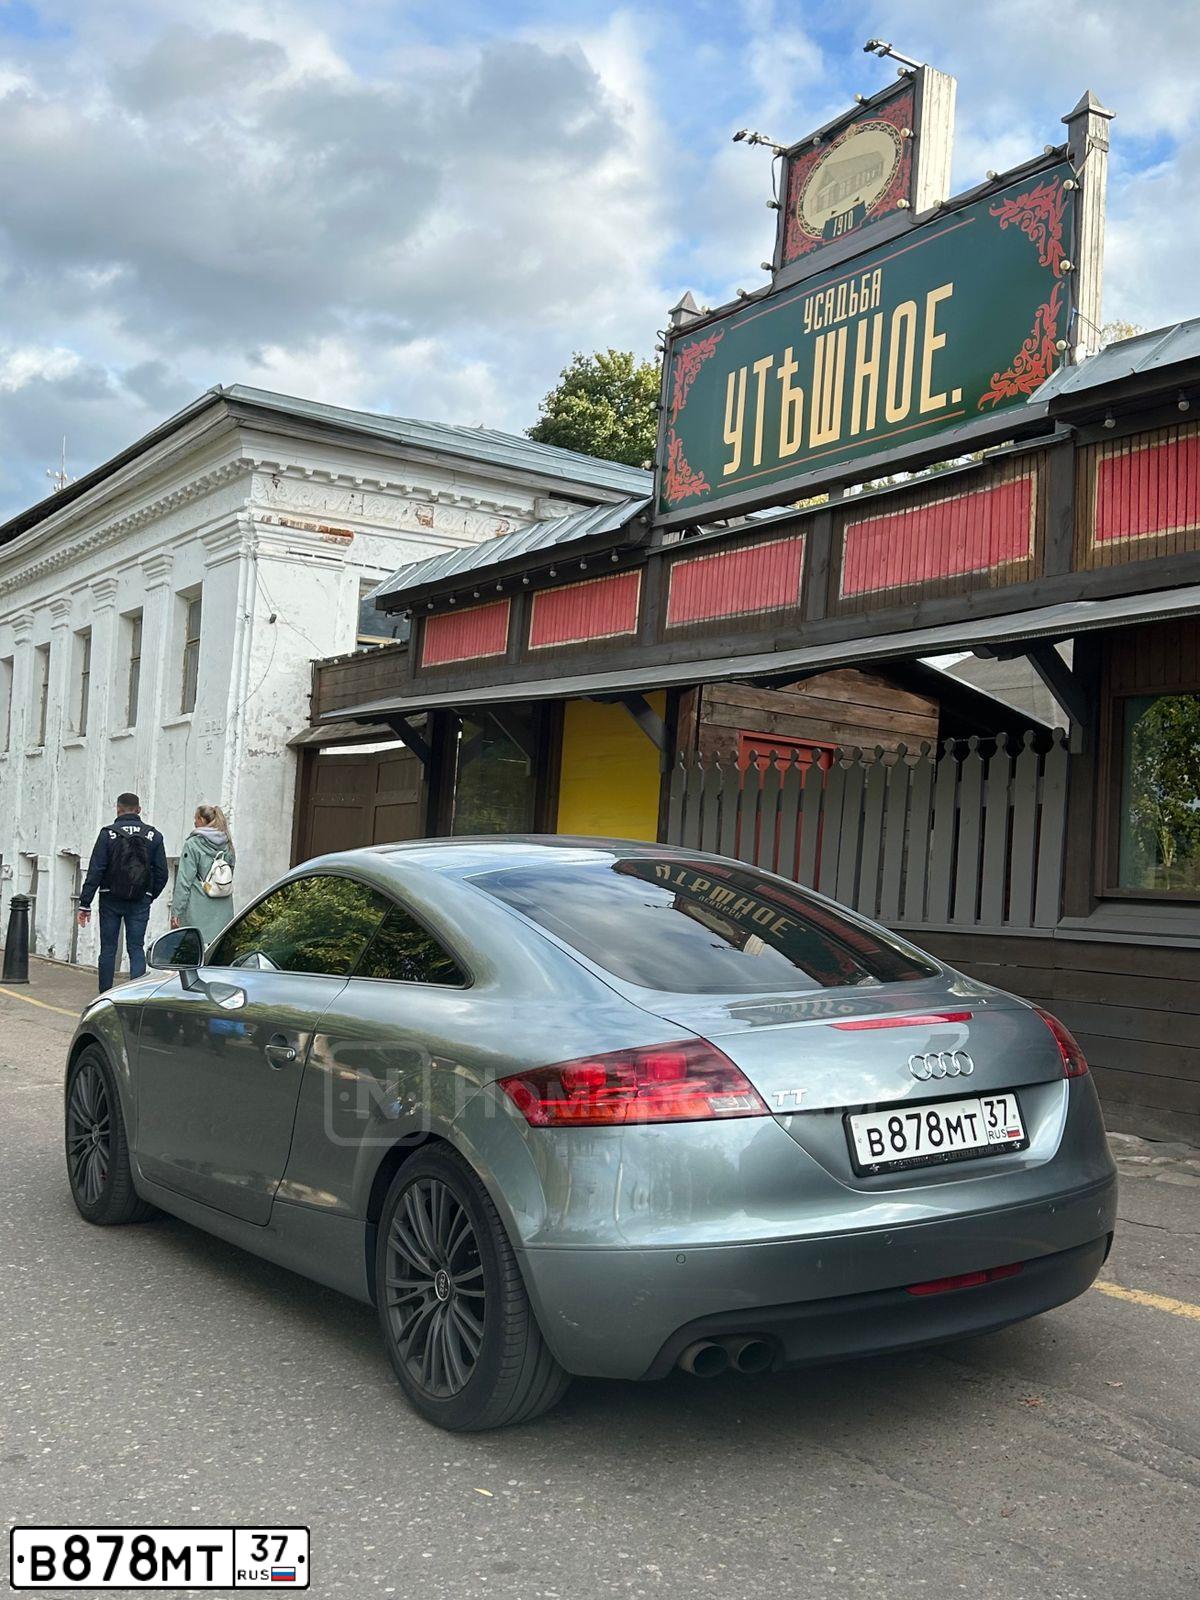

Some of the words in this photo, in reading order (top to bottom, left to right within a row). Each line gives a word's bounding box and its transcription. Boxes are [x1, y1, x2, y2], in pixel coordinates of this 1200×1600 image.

[833, 210, 854, 238] 1910
[803, 268, 882, 334] УСАДЬБА
[772, 1088, 808, 1107] TT
[866, 1110, 978, 1157] В878МТ
[984, 1098, 1008, 1128] 37
[988, 1128, 1007, 1141] RUS
